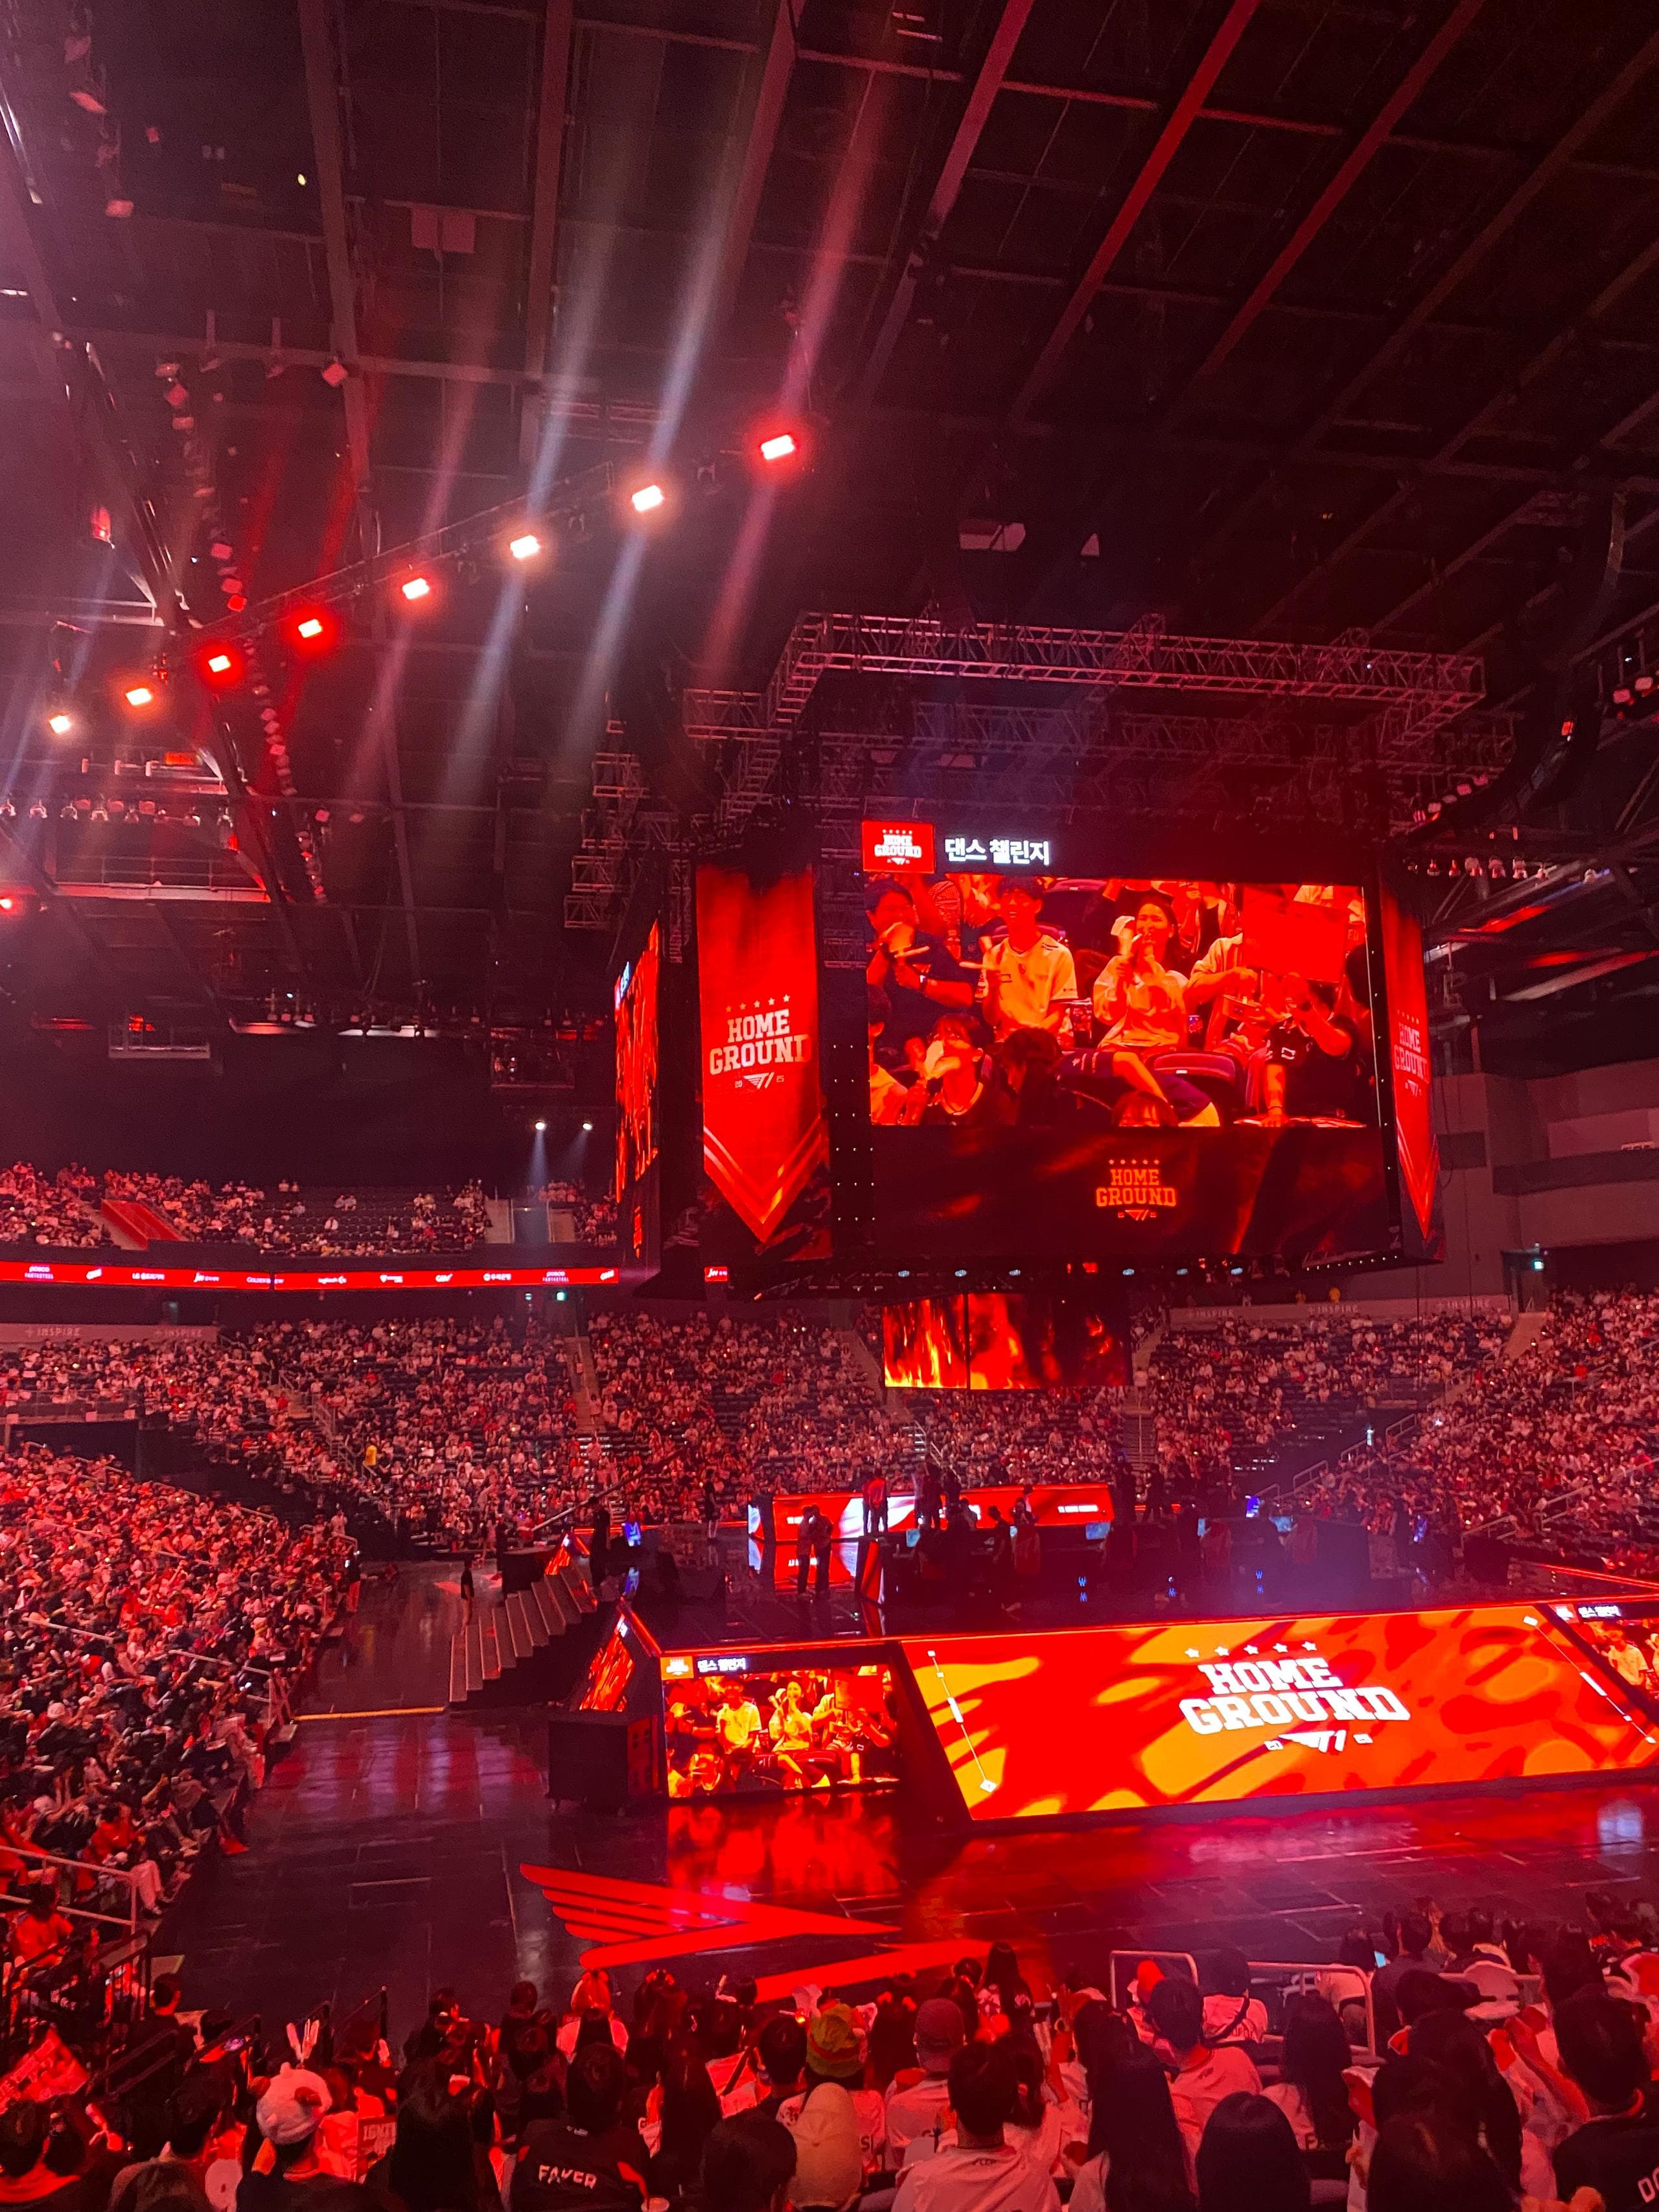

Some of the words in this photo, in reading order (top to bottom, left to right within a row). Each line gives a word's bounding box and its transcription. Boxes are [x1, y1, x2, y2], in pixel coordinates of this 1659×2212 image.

[945, 838, 987, 862] 댄스
[990, 839, 1049, 865] 챌린지
[727, 1008, 790, 1043] HOME
[1398, 1021, 1421, 1053] HOME
[1110, 1169, 1159, 1185] HOME
[1096, 1187, 1177, 1207] GROUND
[38, 1327, 80, 1336] INSPIRE
[1198, 1657, 1343, 1695] HOME
[1179, 1686, 1411, 1735] GROUND
